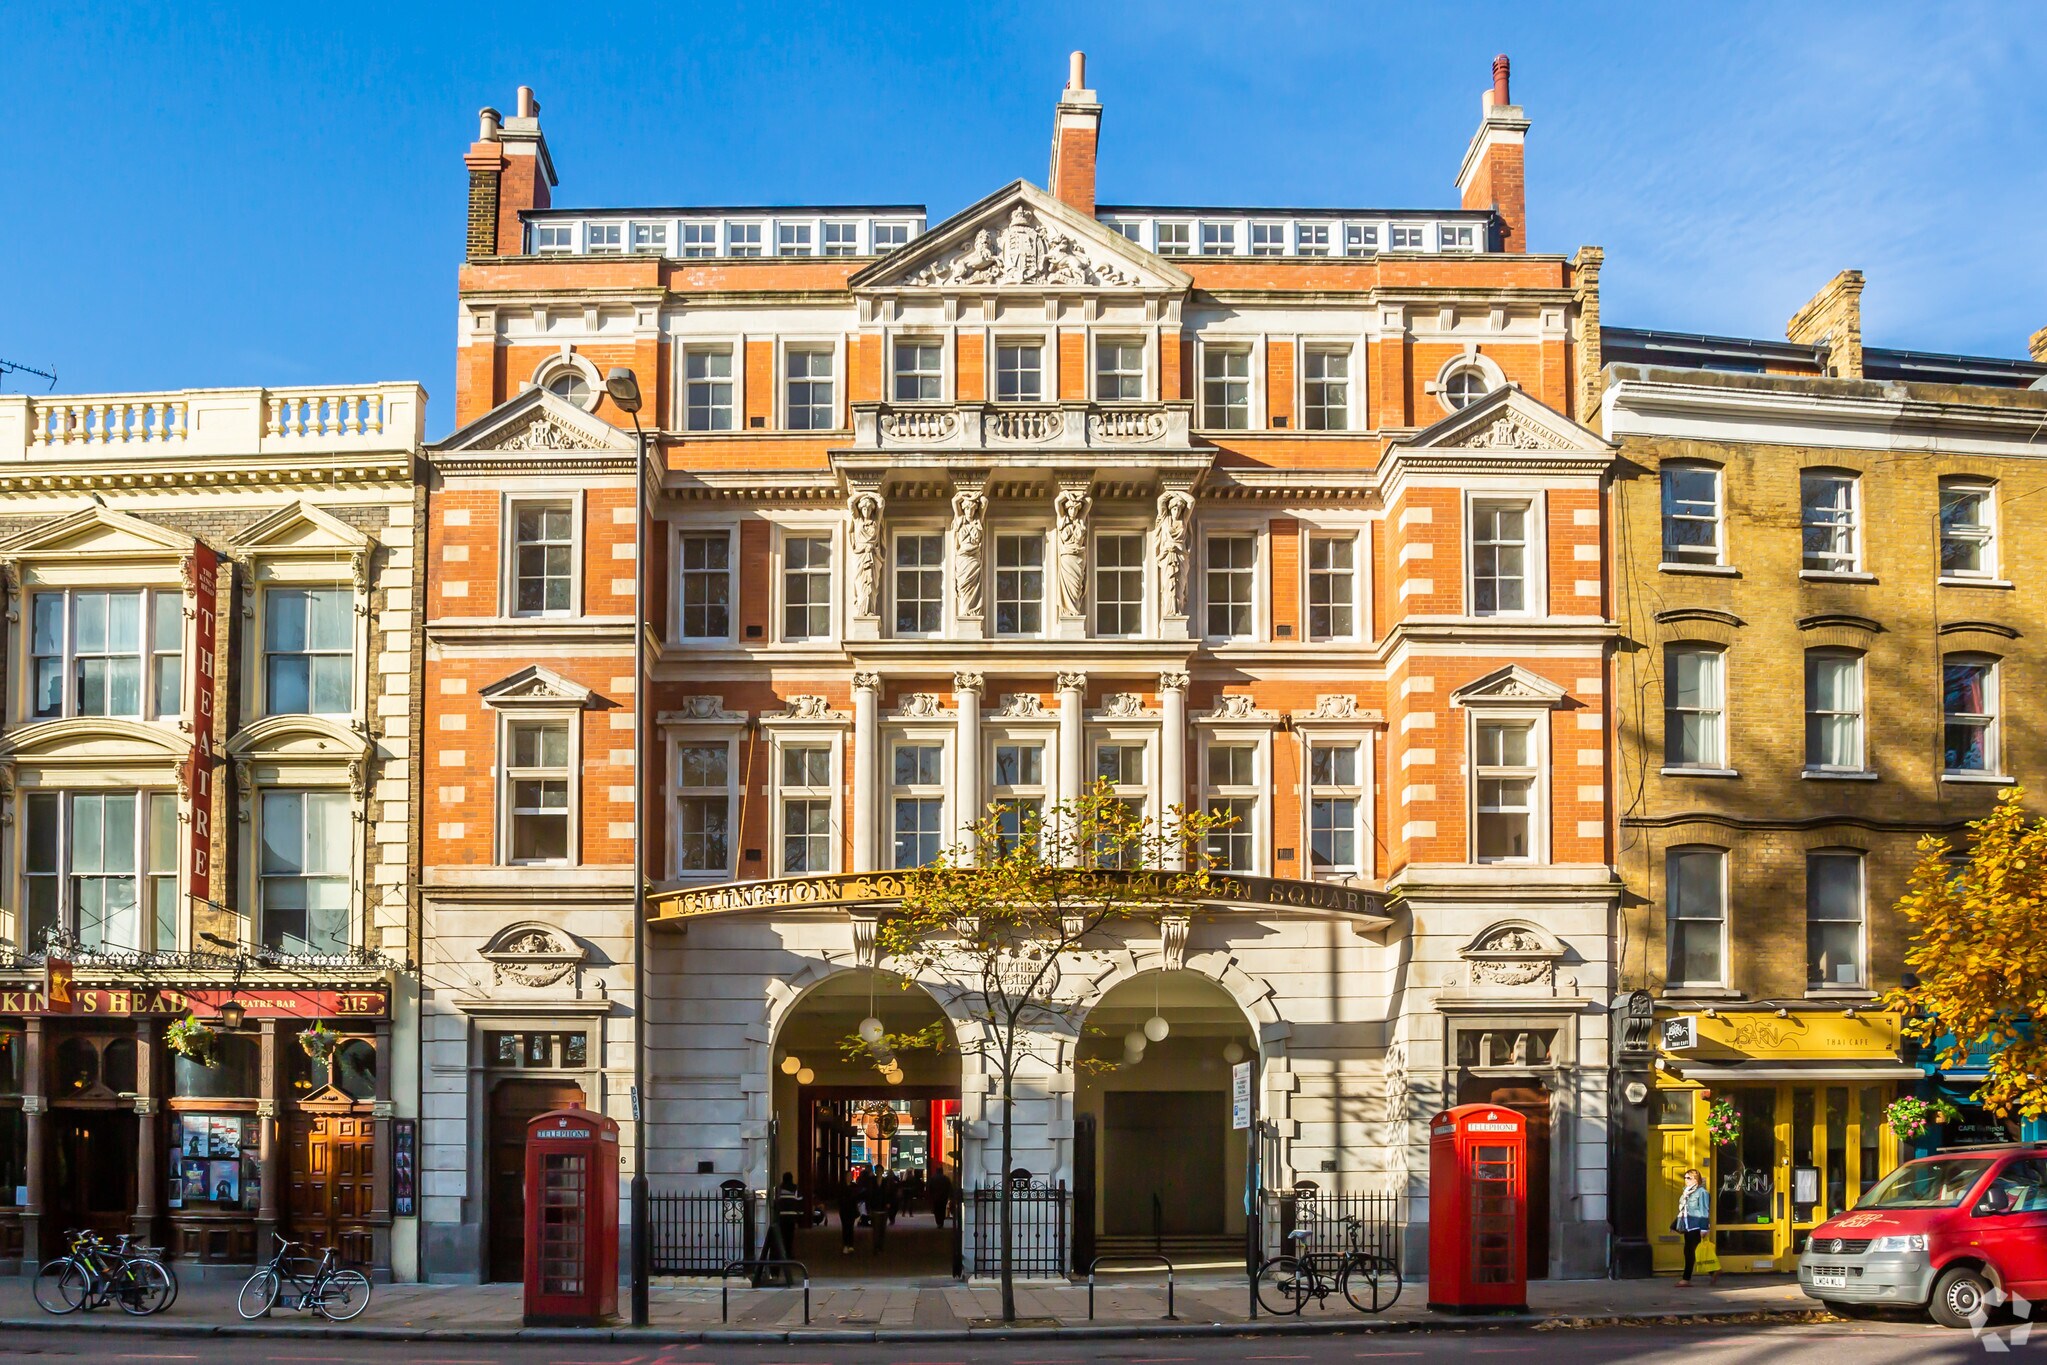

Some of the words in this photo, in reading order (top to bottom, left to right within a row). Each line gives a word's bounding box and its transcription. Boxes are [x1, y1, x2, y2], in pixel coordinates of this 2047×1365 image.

[194, 607, 214, 877] THEATRE
[673, 878, 838, 915] ISLINGTON
[1271, 883, 1376, 913] SQUARE
[1000, 973, 1043, 986] ISTRICT
[2, 992, 97, 1013] KIN'S
[108, 992, 188, 1013] HEAD
[227, 999, 274, 1008] EATRE
[276, 999, 296, 1008] BAR
[342, 996, 368, 1012] 115
[1826, 1038, 1846, 1046] THAI
[1849, 1038, 1869, 1046] CAFE
[538, 1130, 589, 1138] TELEPHONE
[1469, 1123, 1515, 1132] TELEPHONE
